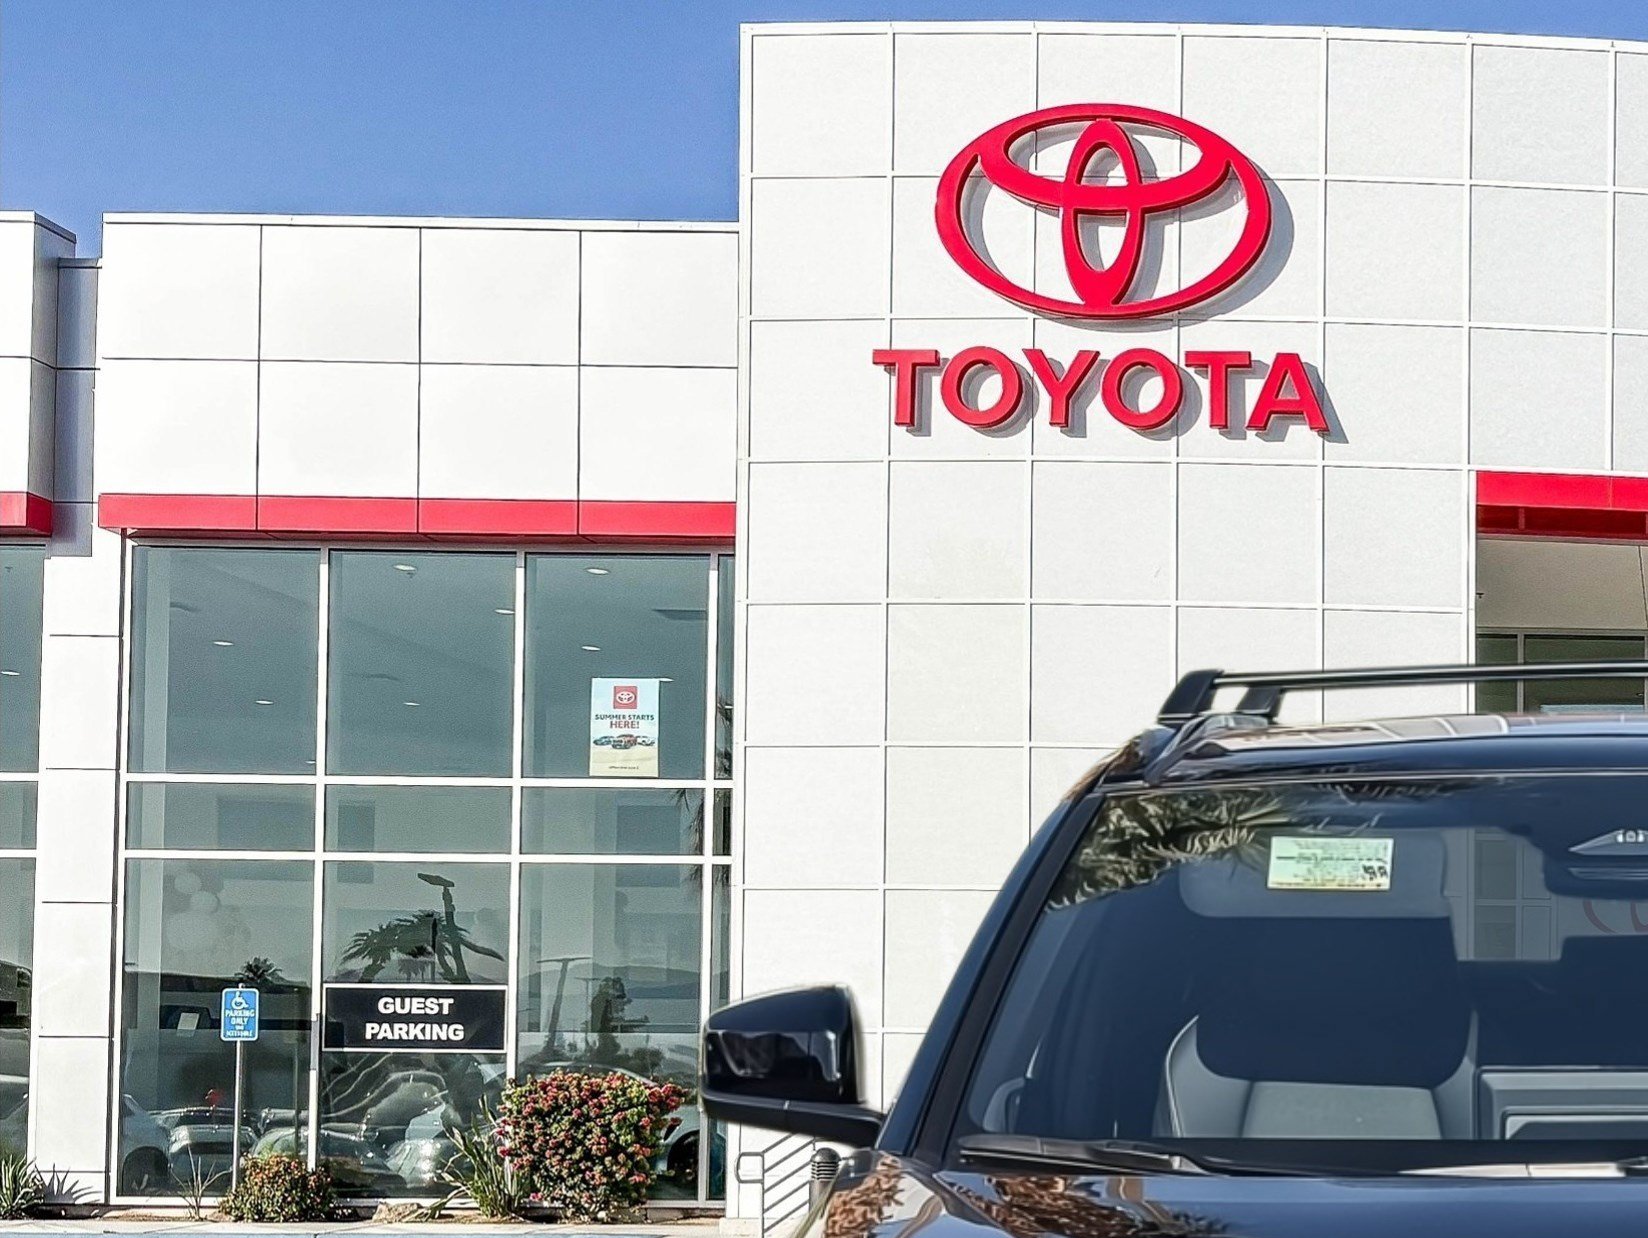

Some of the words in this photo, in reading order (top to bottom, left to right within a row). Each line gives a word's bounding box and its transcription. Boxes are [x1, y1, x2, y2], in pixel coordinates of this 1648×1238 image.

[872, 345, 1331, 434] TOYOTA
[609, 721, 640, 729] HERE!
[377, 997, 454, 1015] GUEST
[225, 1009, 256, 1017] PARKING
[230, 1017, 249, 1025] ONLY
[365, 1023, 465, 1041] PARKING
